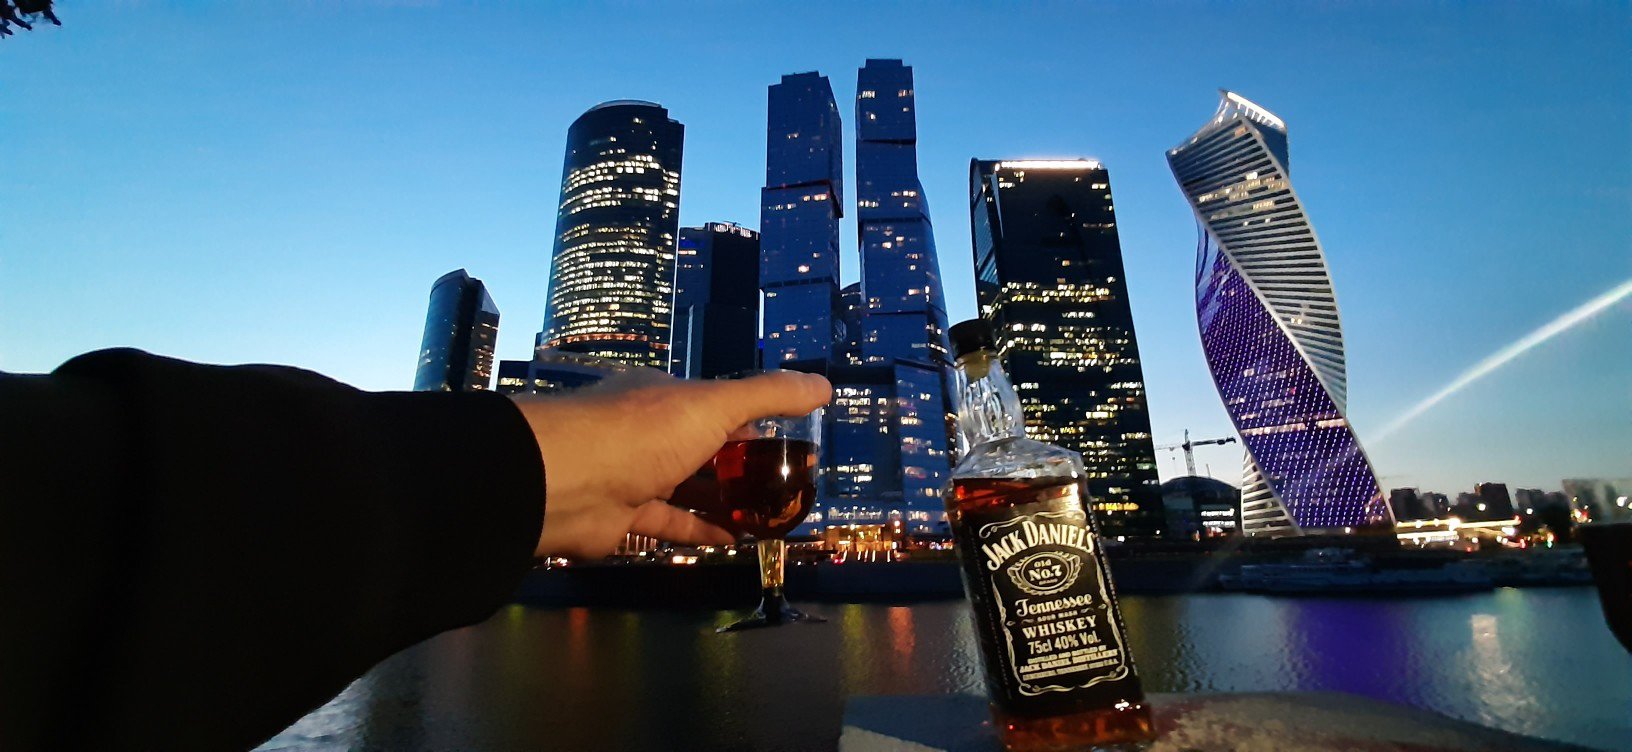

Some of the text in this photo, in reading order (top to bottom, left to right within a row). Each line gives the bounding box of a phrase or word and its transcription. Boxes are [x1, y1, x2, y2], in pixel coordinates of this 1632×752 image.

[981, 520, 1095, 571] JACK DANIEL'S
[1014, 593, 1092, 617] Tennessee
[1022, 614, 1096, 639] WHISKEY
[1027, 638, 1053, 655] 75cl
[1054, 633, 1079, 650] 40%
